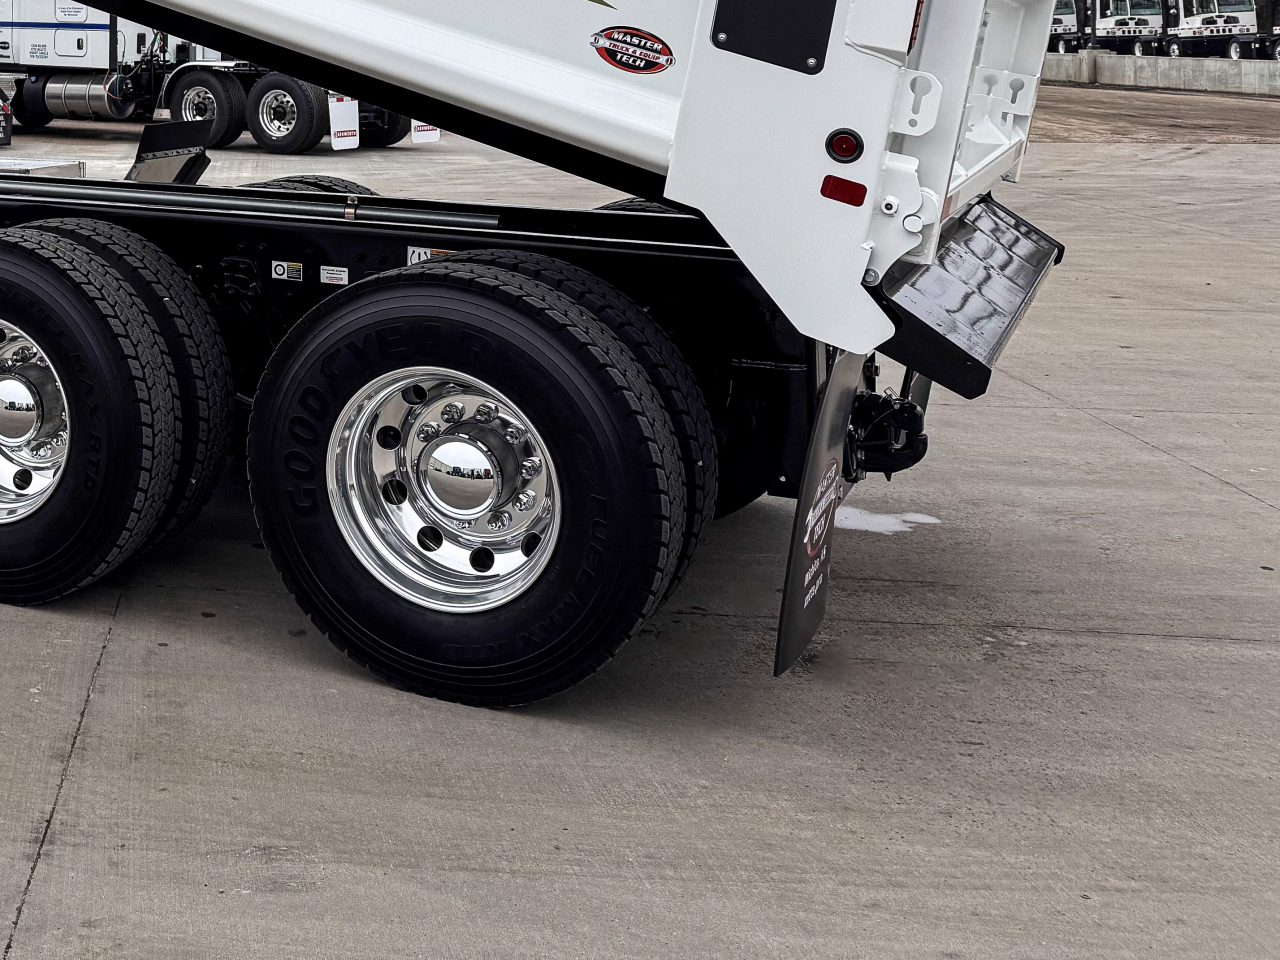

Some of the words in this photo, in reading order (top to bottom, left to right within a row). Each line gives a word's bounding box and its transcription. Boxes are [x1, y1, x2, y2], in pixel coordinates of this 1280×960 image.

[611, 30, 663, 51] MASTER
[608, 41, 631, 52] TRUCK
[638, 51, 661, 61] EQUIP
[616, 53, 646, 68] TECH
